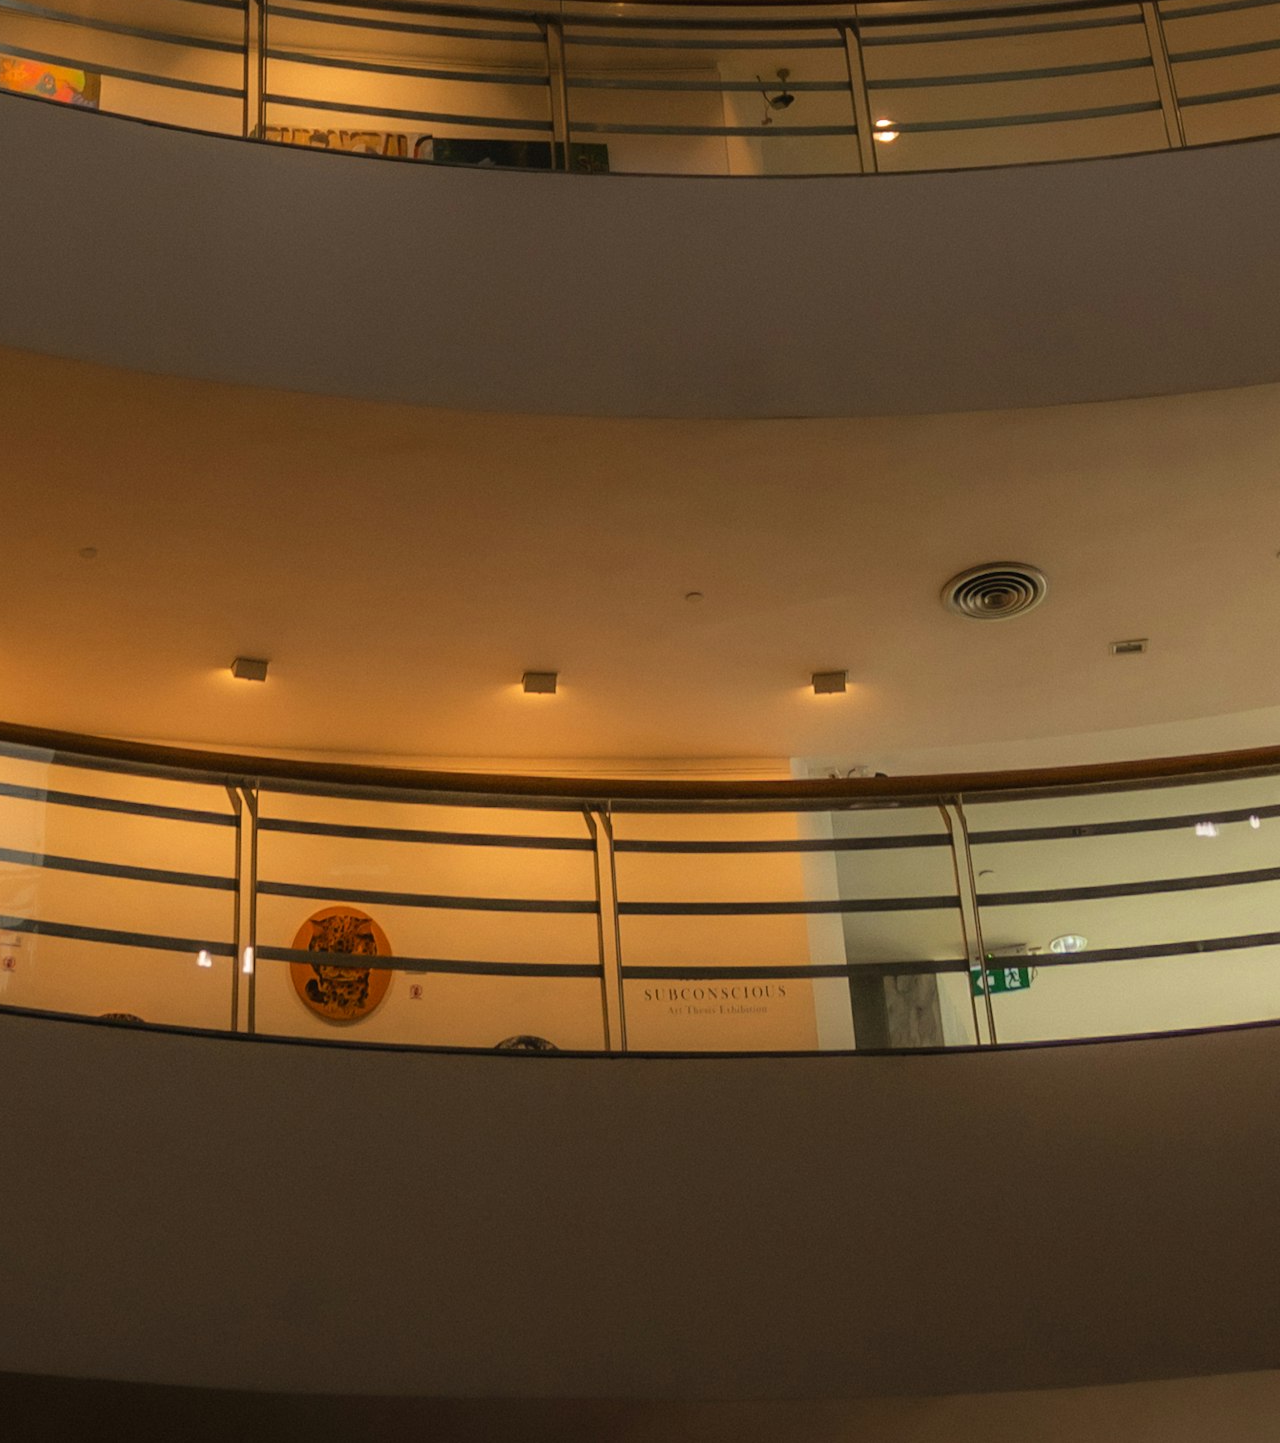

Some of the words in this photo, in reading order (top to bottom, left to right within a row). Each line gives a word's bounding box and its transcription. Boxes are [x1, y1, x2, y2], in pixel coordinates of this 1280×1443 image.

[644, 985, 786, 1001] SUBCONSCIOUS
[668, 1005, 683, 1014] Art
[687, 1005, 716, 1014] Thesis
[720, 1004, 768, 1014] Exhibition
